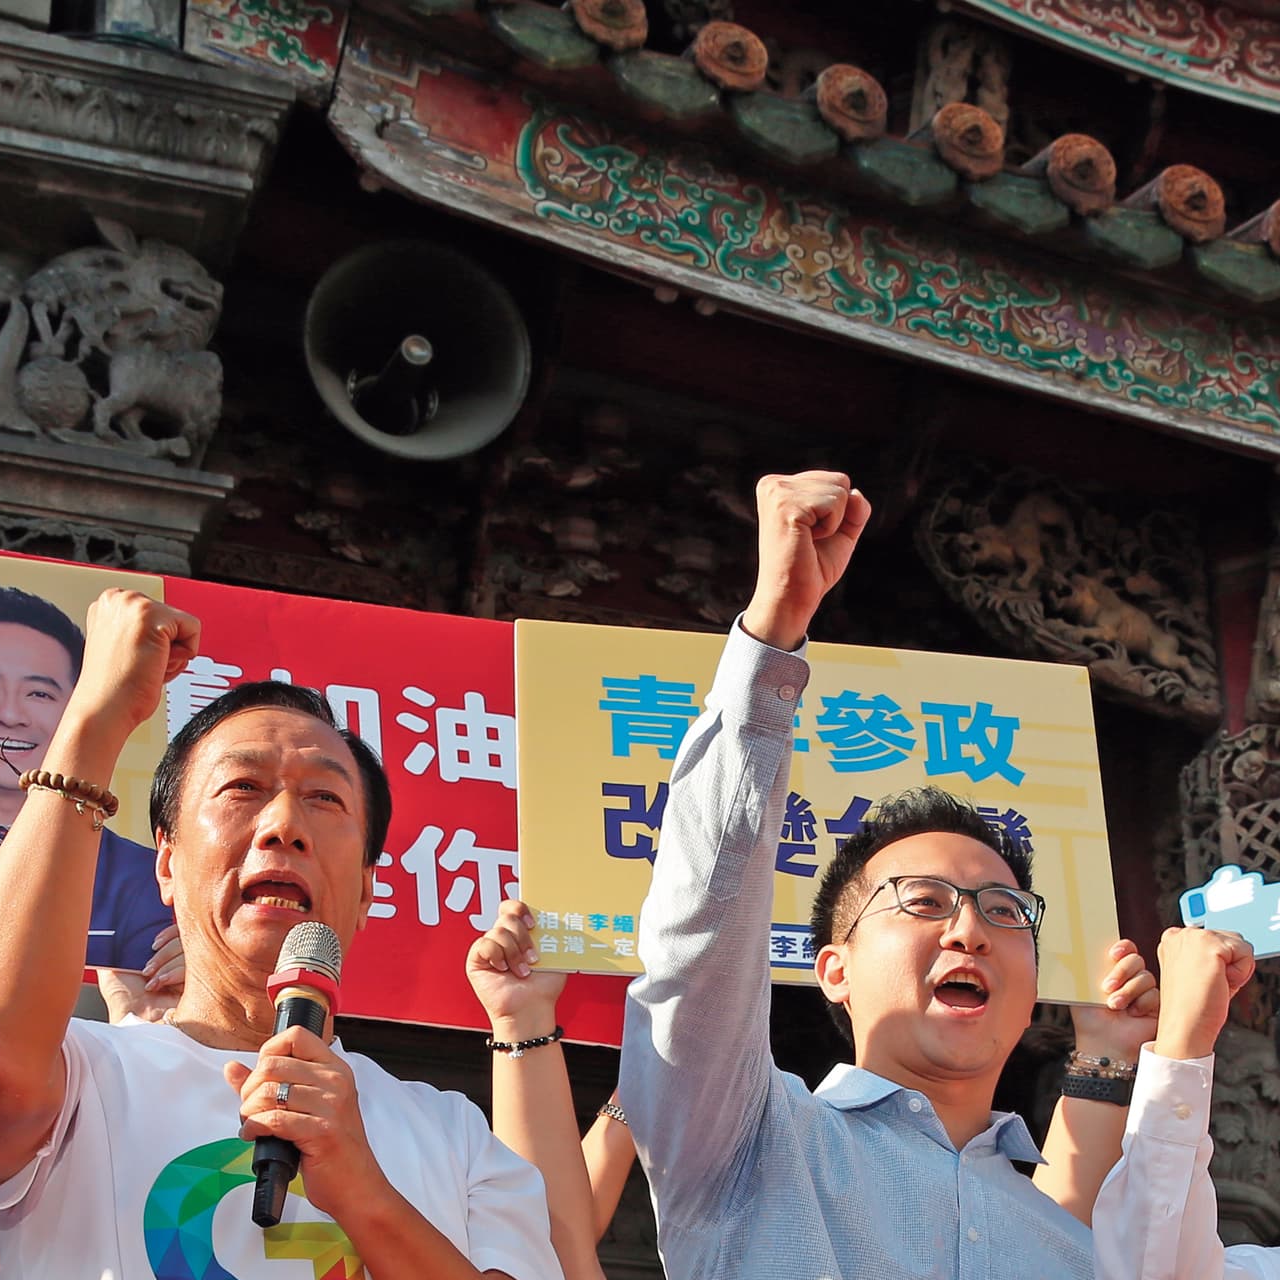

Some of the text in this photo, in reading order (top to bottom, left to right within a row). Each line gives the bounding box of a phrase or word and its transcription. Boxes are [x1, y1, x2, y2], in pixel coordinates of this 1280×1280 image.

[599, 675, 1026, 787] 青參政
[537, 911, 640, 934] 相信李縉
[539, 934, 636, 957] 台灣一定
